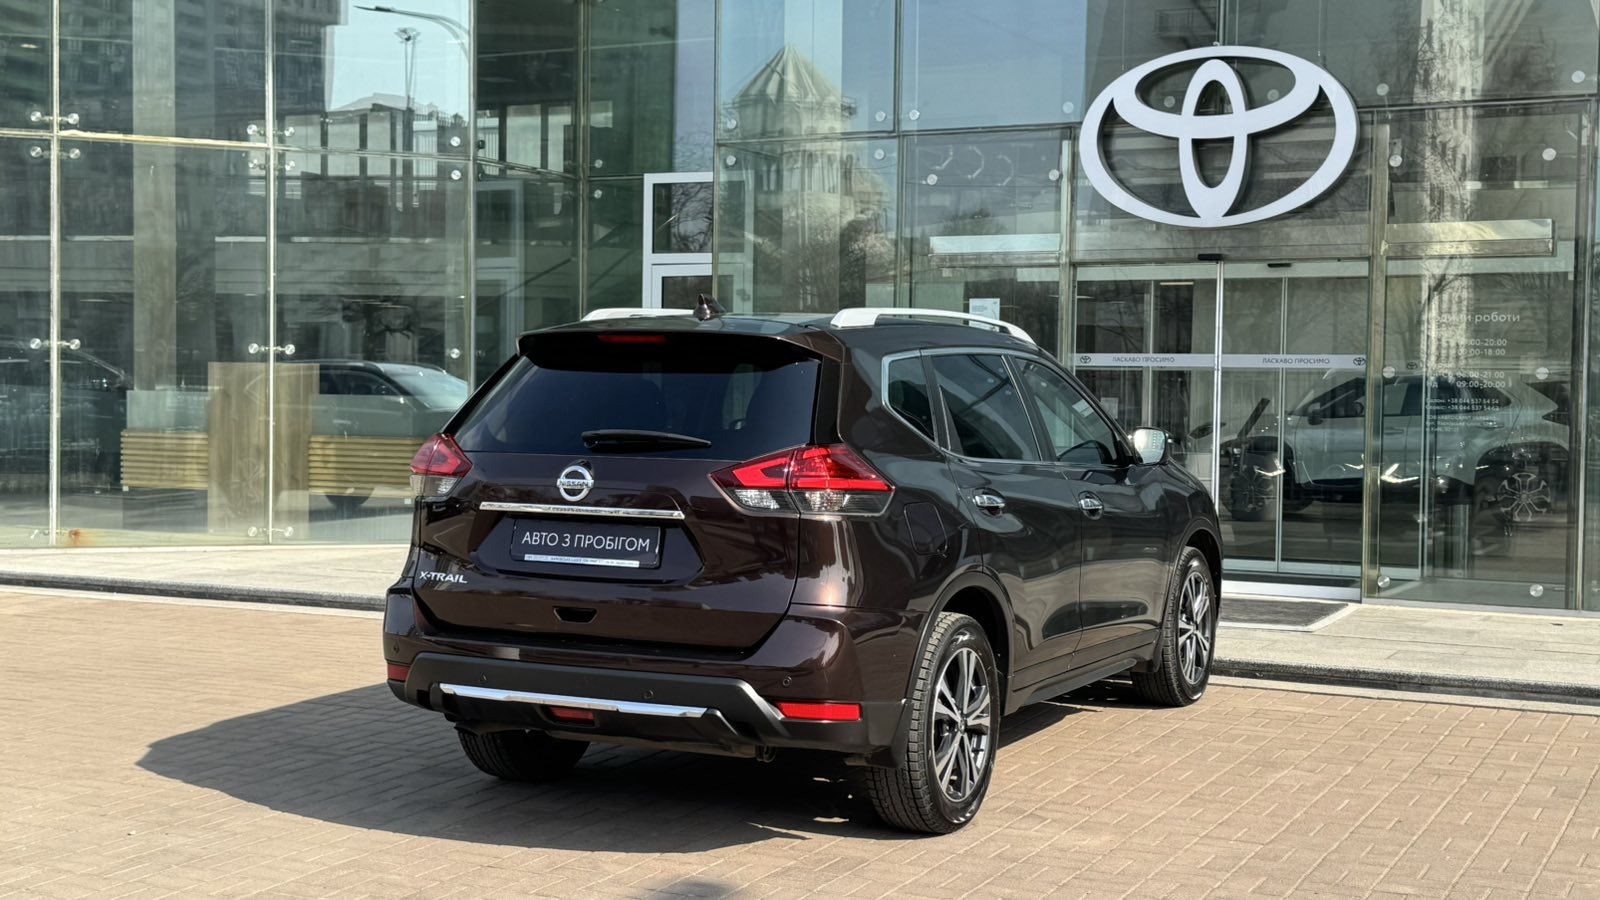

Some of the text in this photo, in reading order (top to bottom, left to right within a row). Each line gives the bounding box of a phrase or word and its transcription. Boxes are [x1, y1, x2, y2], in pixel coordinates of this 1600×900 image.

[1474, 312, 1520, 325] роботи
[1294, 357, 1330, 365] ПРОСИМО
[521, 531, 559, 547] АВТО
[574, 534, 650, 552] ПРОБІГОМ
[419, 571, 468, 584] X-TRAIL
